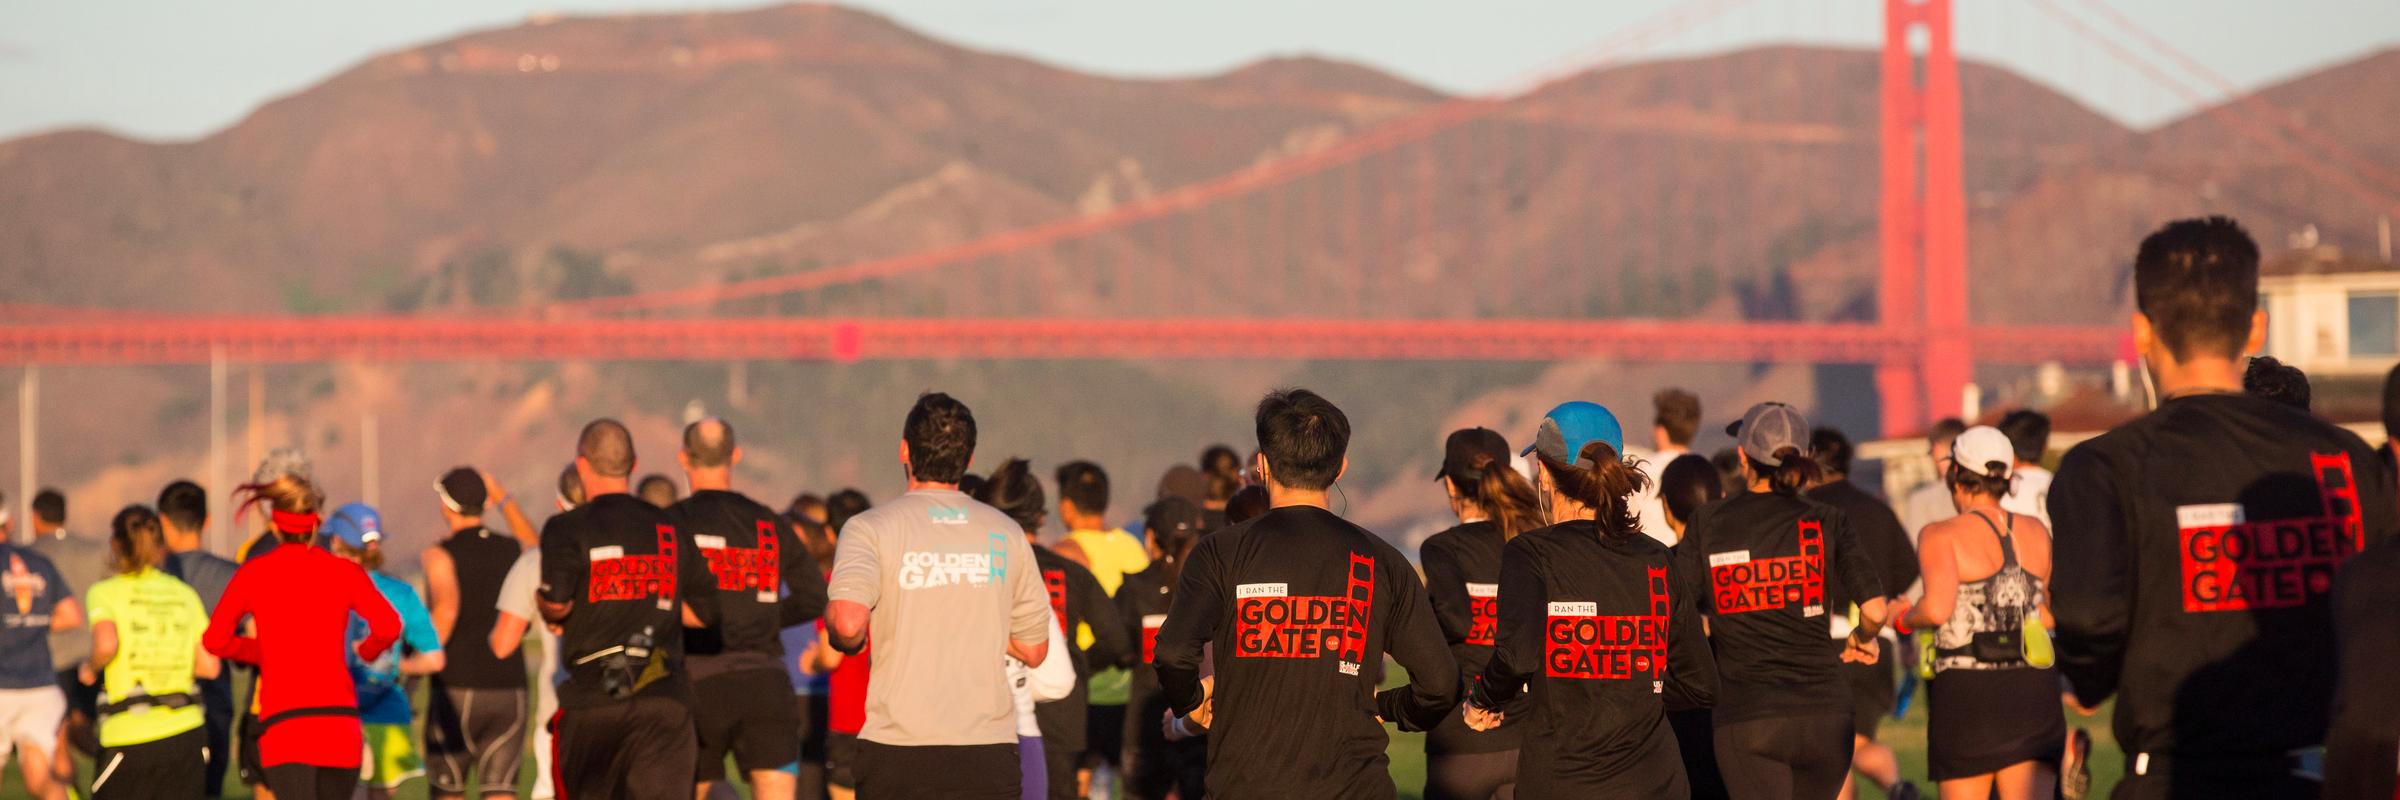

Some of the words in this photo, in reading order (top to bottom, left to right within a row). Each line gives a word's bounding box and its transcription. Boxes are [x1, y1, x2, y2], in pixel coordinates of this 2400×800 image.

[2189, 523, 2355, 563] GOLDEN
[596, 559, 673, 577] GOLDEN
[903, 552, 990, 567] GOLDEN
[899, 566, 989, 589] GATE
[1716, 560, 1820, 586] GOLDEN
[2192, 565, 2298, 603] GATE
[594, 580, 641, 597] GATE
[1718, 586, 1780, 609] GATE
[1241, 599, 1367, 629] GOLDEN
[1241, 628, 1317, 654] GATE
[1550, 619, 1667, 646] GOLDEN
[1550, 648, 1627, 675] GATE
